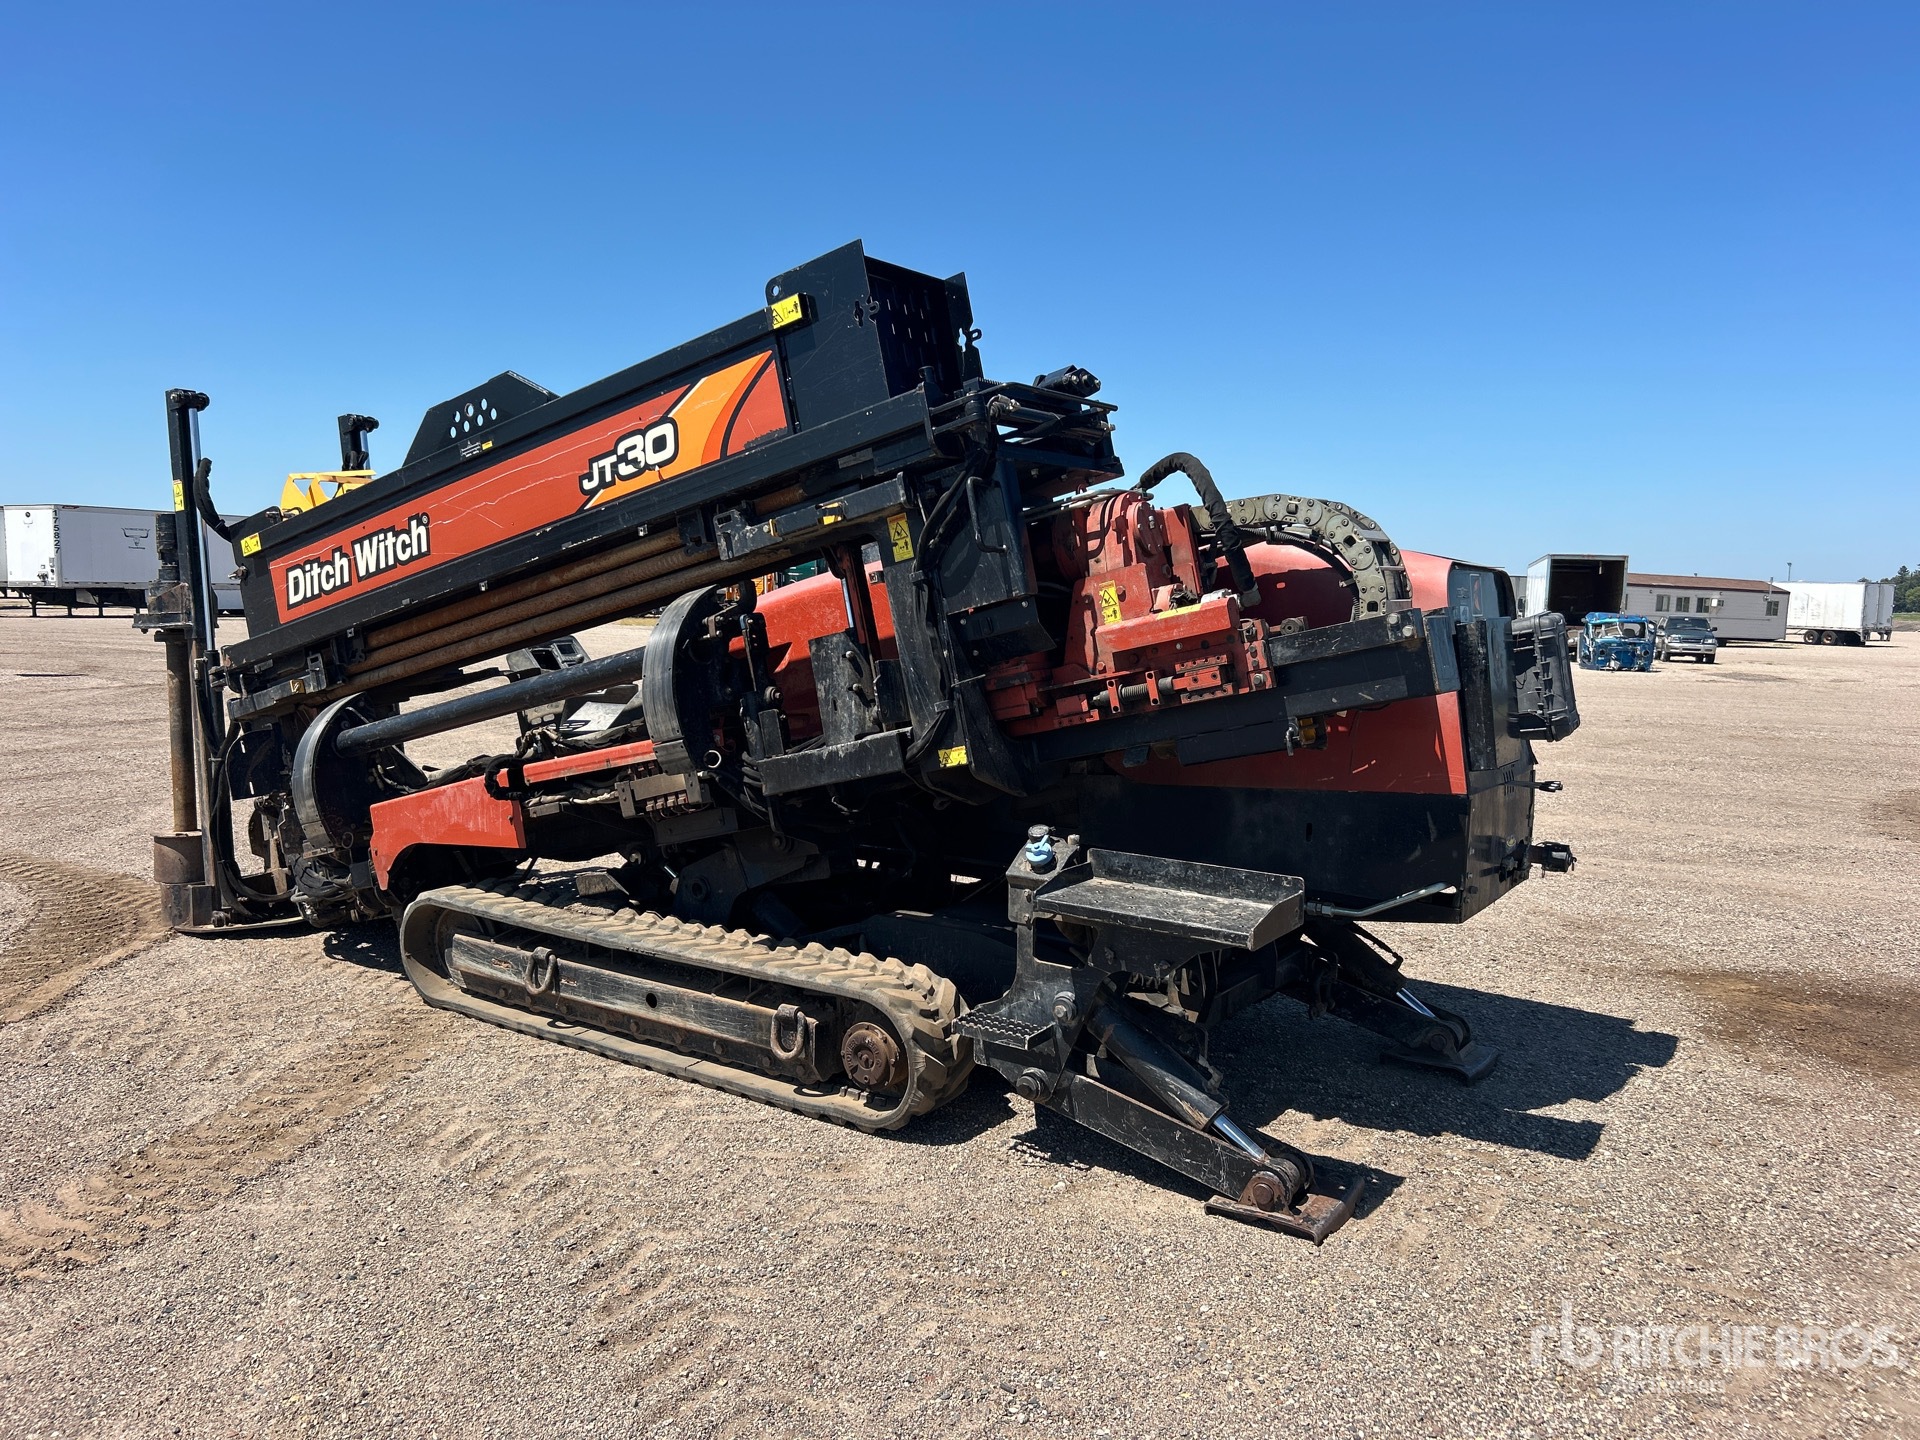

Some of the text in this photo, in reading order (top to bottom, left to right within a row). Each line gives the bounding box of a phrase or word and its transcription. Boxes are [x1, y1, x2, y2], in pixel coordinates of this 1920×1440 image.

[582, 422, 675, 491] JT30
[52, 509, 61, 554] 175827
[287, 518, 429, 606] Ditch Witch
